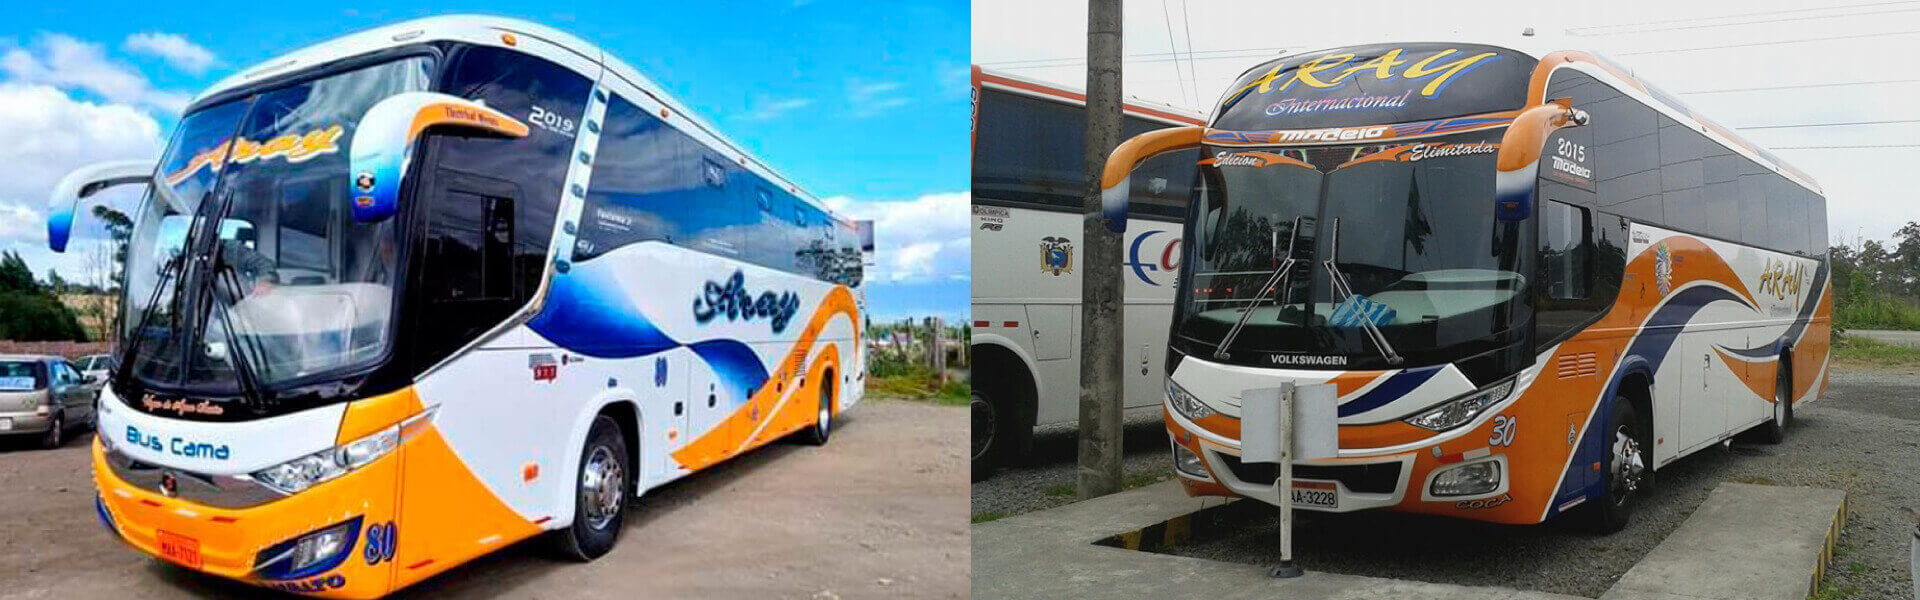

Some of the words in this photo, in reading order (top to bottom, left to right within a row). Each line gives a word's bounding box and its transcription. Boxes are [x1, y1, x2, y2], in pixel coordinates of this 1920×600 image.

[1224, 48, 1501, 106] ARAY
[1265, 88, 1413, 116] Internacional
[528, 105, 575, 132] 2019
[1213, 151, 1258, 168] Edicion
[1410, 140, 1495, 163] Elimitada
[1557, 137, 1586, 163] 2015
[1758, 255, 1804, 313] ARAY
[693, 267, 800, 335] Aray
[1270, 353, 1348, 366] VOLKSWAGEN
[126, 425, 163, 453] Bus
[170, 437, 230, 460] Cama
[1488, 414, 1517, 447] 30
[1291, 489, 1336, 506] AA-3228
[1454, 493, 1514, 510] COCA
[364, 520, 398, 566] 80
